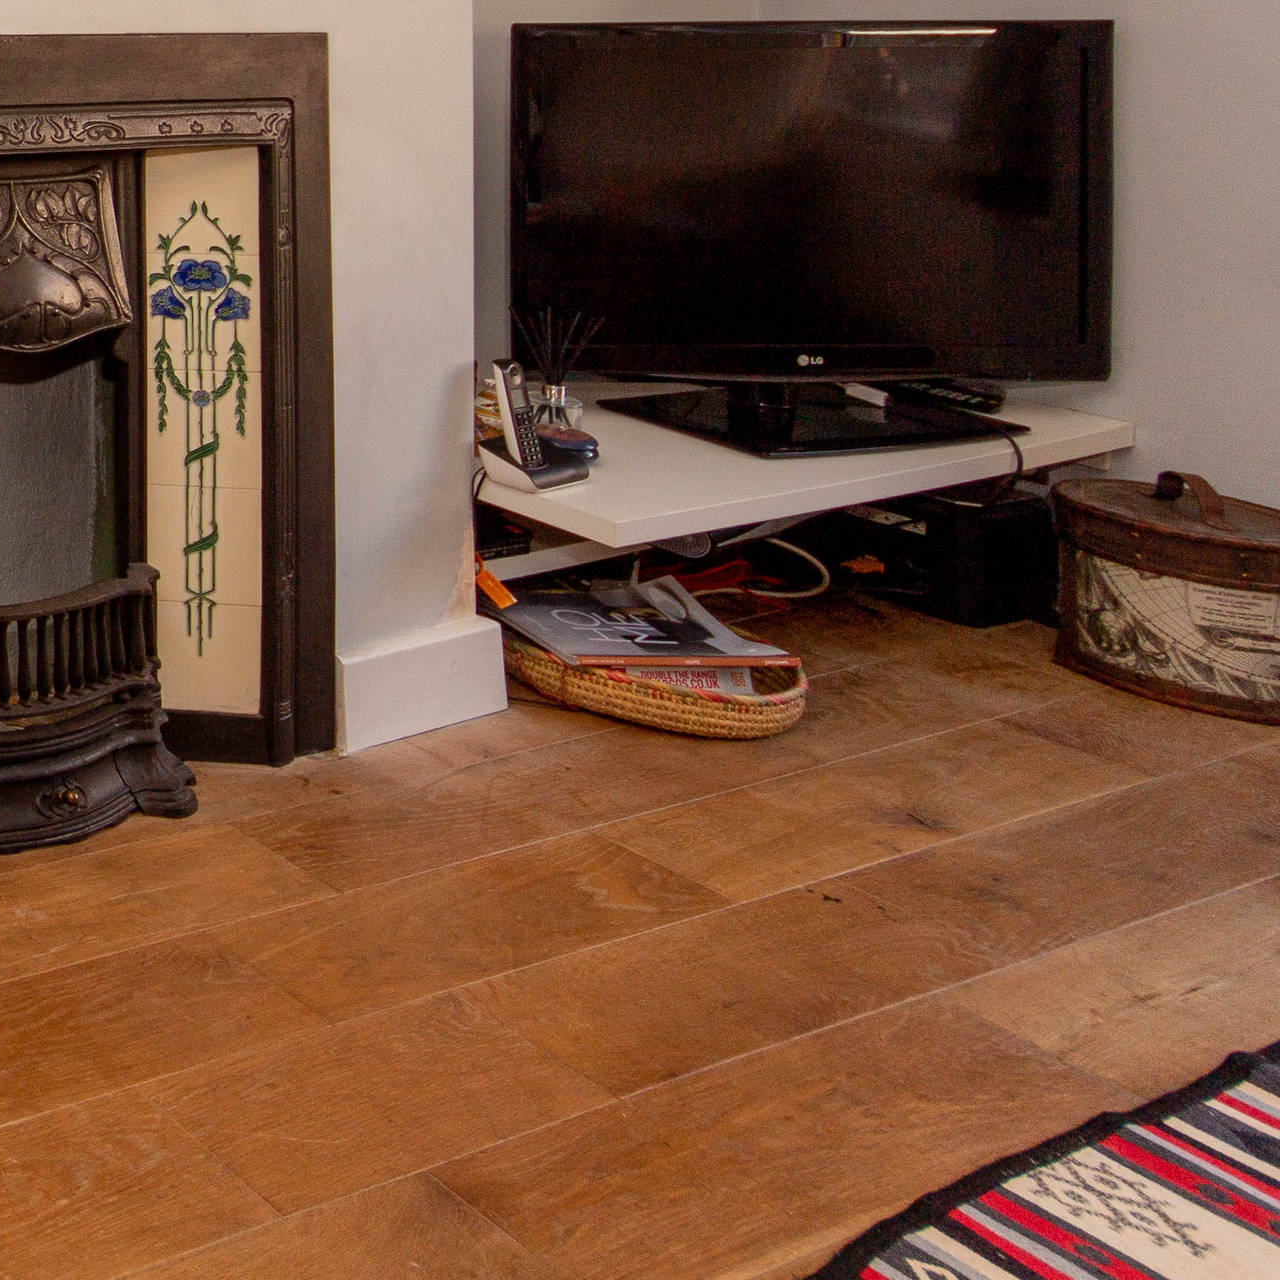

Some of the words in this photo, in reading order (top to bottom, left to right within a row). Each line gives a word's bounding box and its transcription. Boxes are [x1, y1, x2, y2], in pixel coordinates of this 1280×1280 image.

[810, 356, 824, 365] LG
[640, 669, 672, 680] DOUBLE
[672, 669, 689, 680] THE
[691, 670, 719, 680] RANGE
